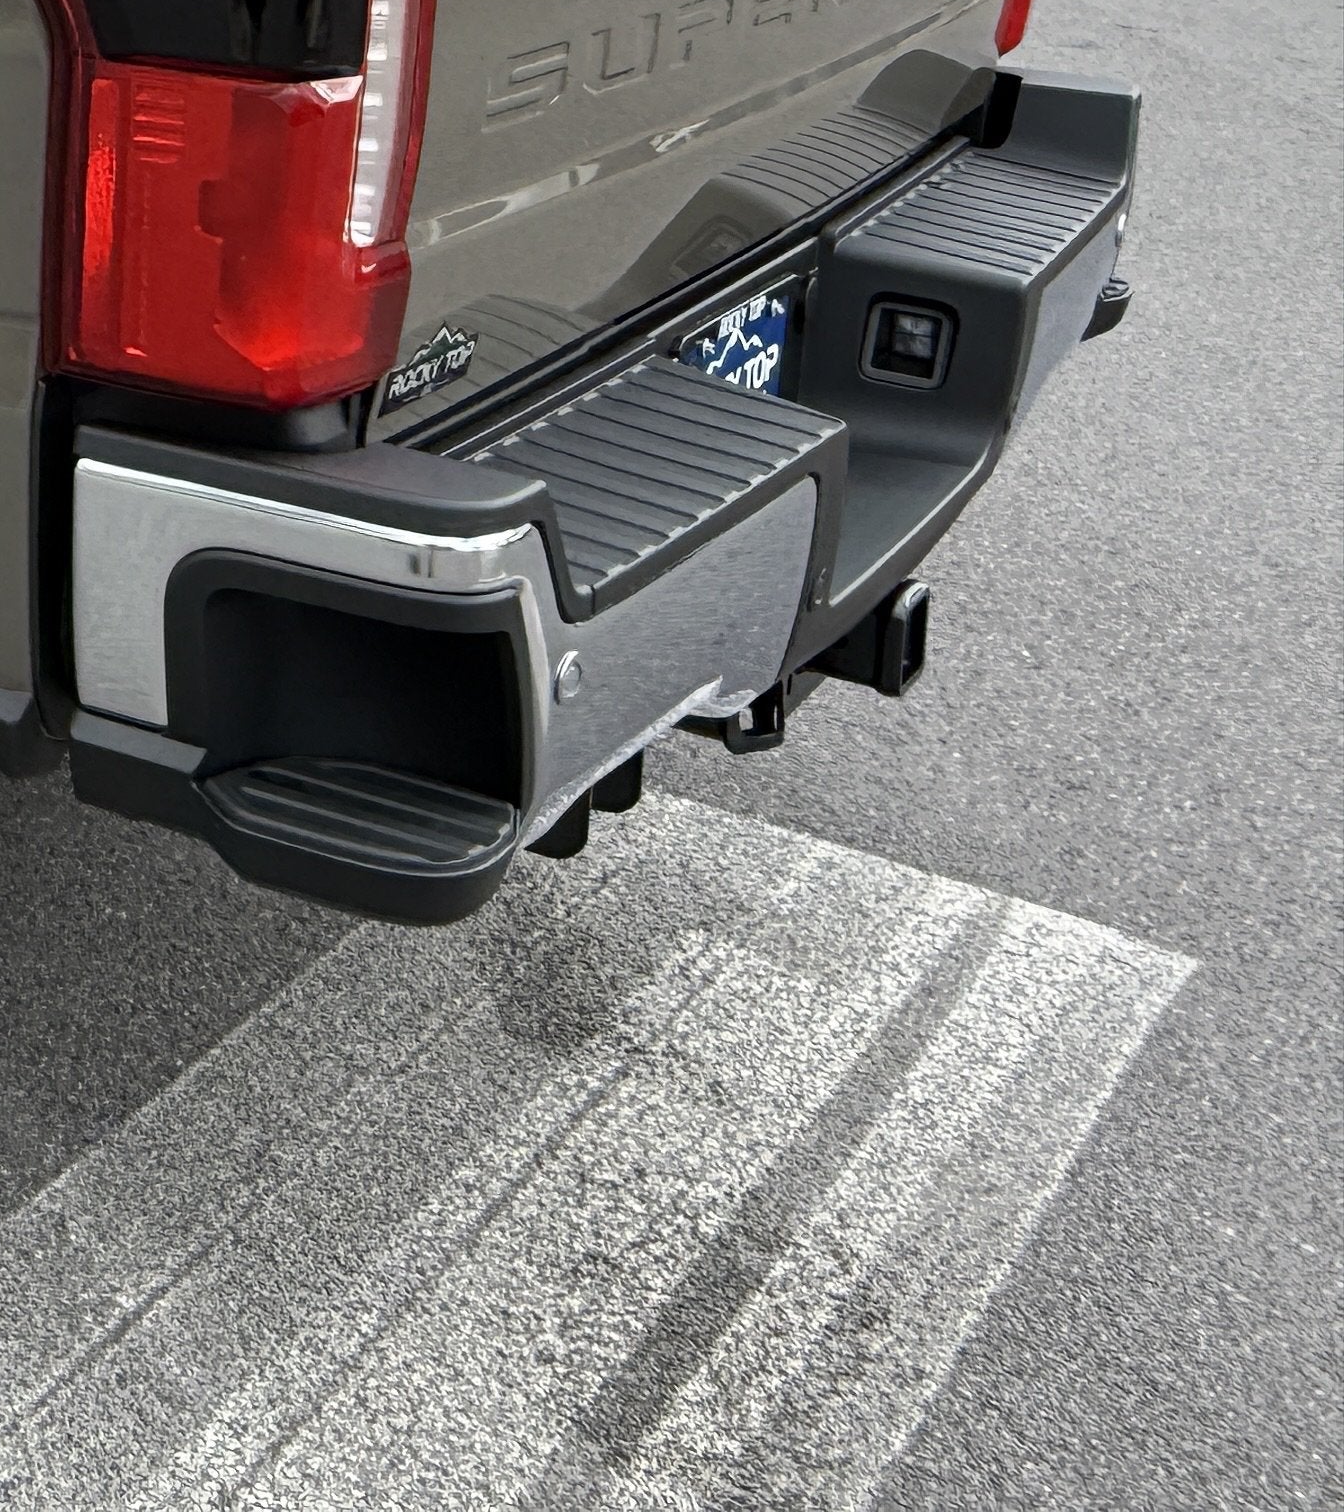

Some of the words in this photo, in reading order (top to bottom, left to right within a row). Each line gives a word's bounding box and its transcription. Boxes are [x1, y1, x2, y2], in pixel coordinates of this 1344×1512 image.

[388, 354, 444, 400] ROCKY
[444, 340, 476, 373] TOP
[744, 343, 779, 390] TOP
